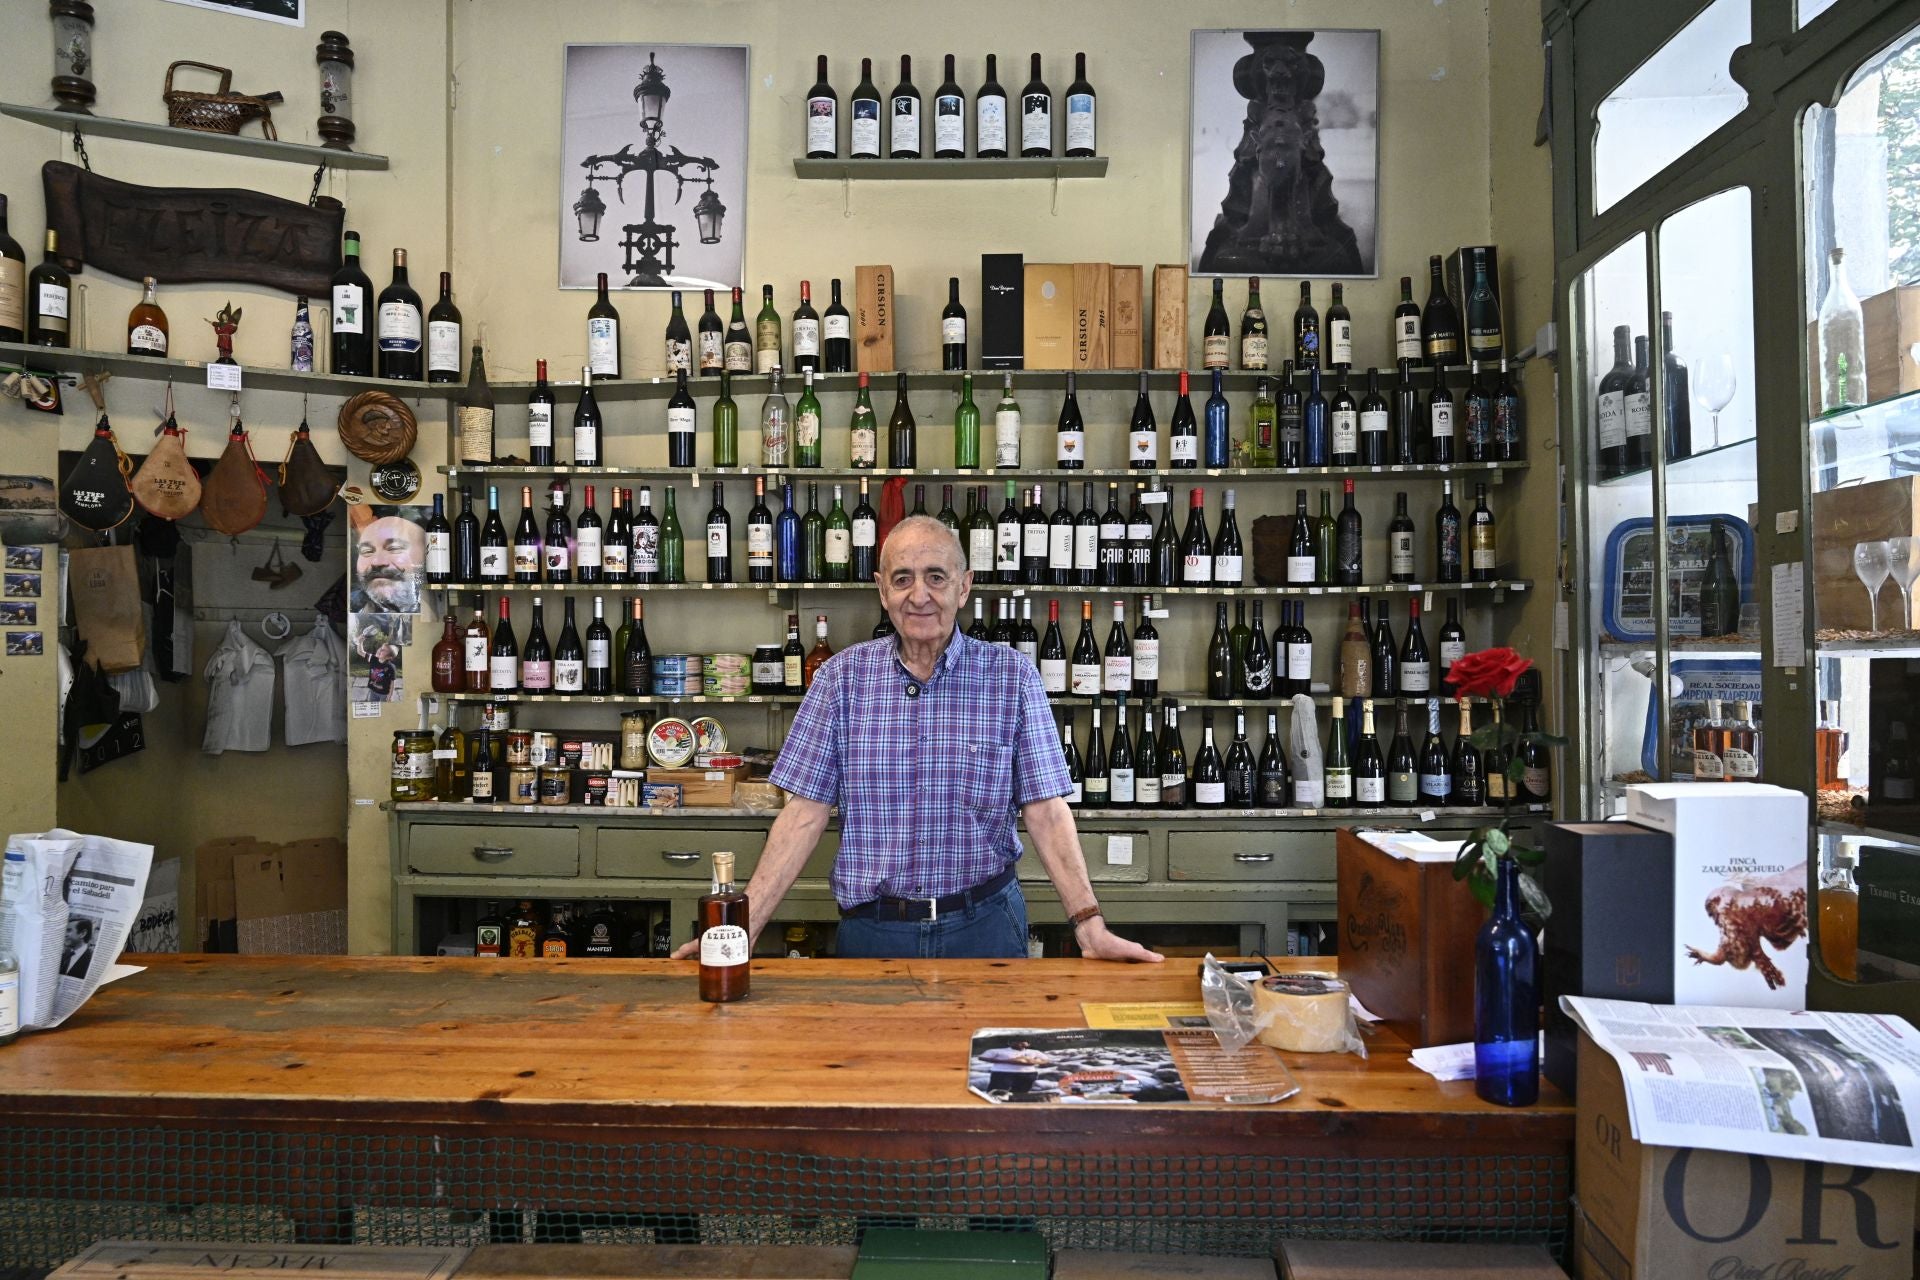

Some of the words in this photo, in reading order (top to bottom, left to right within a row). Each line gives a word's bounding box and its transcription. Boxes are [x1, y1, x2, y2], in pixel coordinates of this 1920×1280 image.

[876, 274, 886, 326] CIRSION
[1079, 309, 1087, 361] CIRSION
[1101, 548, 1124, 564] CAIR
[1127, 548, 1151, 564] CAIR
[1729, 857, 1757, 865] FINCA
[1702, 864, 1785, 876] ZARZAMOCHUELO
[72, 886, 80, 895] el
[81, 887, 111, 900] Sabadell
[99, 883, 115, 893] para
[140, 910, 175, 932] BODEGA
[707, 931, 743, 940] EZEIZA
[544, 944, 565, 953] STROH
[1595, 1113, 1622, 1162] OR
[1663, 1147, 1901, 1249] OR
